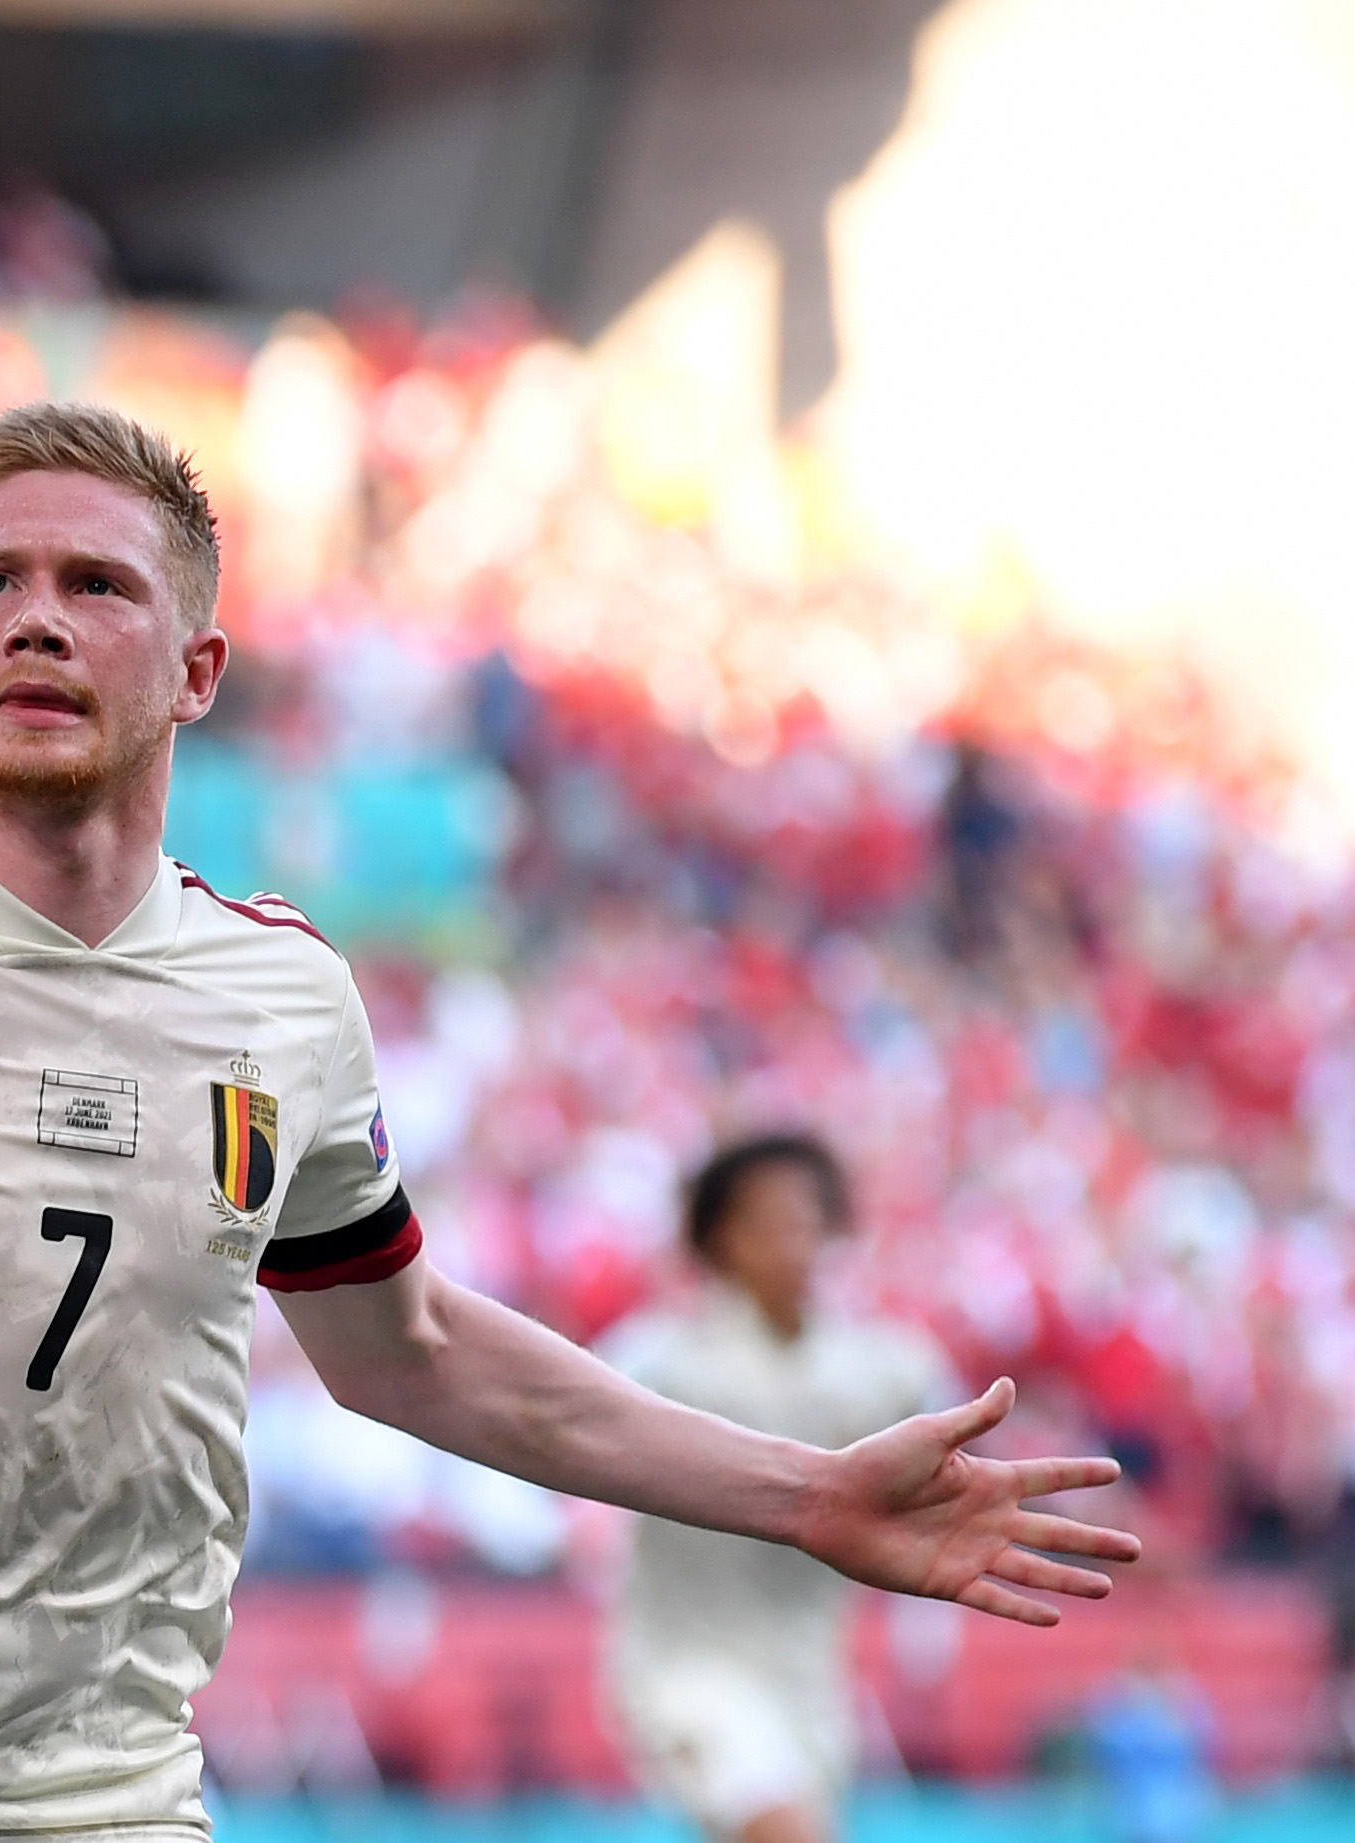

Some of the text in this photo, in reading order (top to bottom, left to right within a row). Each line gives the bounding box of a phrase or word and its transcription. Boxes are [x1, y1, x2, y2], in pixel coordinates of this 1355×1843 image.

[72, 1097, 106, 1109] DENMARK
[65, 1106, 112, 1121] 17 JUNE 2021
[207, 1240, 226, 1255] 125
[26, 1207, 113, 1391] 7
